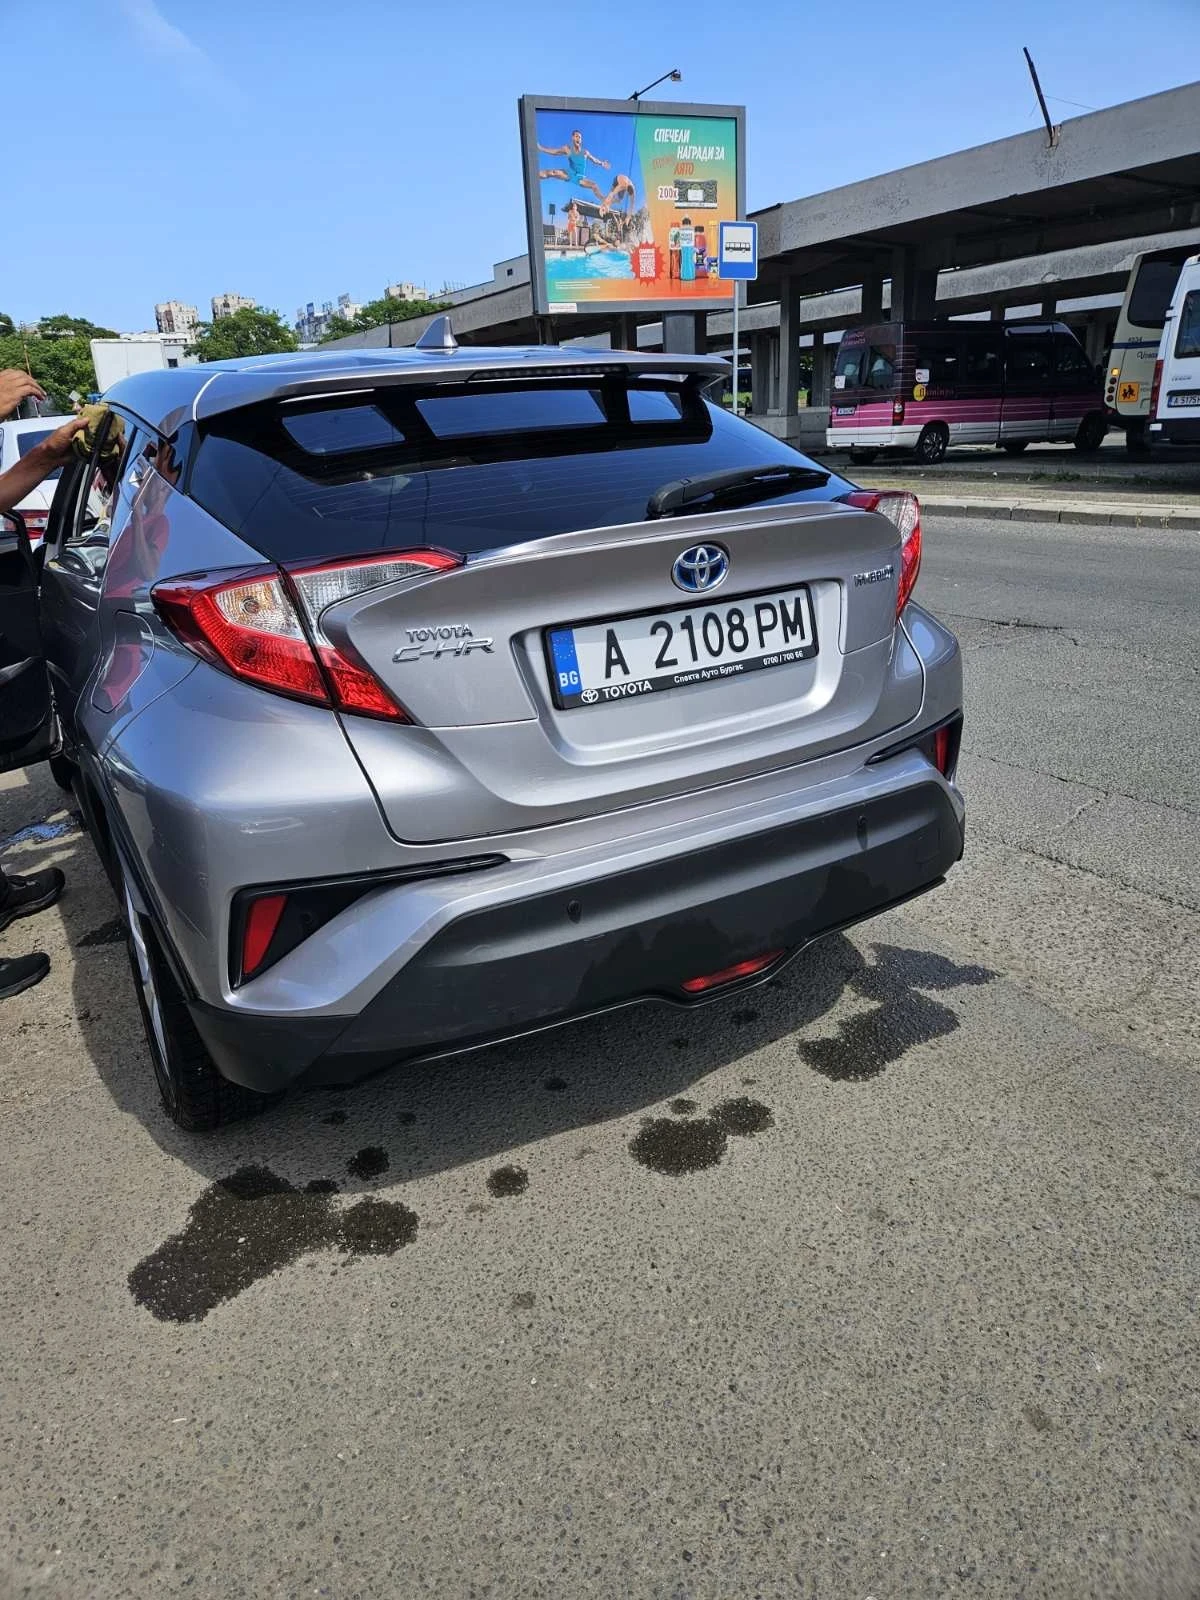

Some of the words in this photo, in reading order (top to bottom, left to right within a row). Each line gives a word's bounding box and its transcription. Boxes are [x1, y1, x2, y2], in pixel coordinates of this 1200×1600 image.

[654, 128, 690, 143] СПЕЧЕЛИ
[677, 145, 714, 161] НАГРАДИ
[714, 146, 725, 160] ЗА
[406, 624, 473, 642] TOYOTA
[605, 629, 631, 679] A
[650, 608, 749, 669] 2108
[754, 597, 806, 649] PM
[392, 637, 495, 663] C-HR
[559, 670, 579, 687] BG
[701, 669, 719, 679] Ауто
[719, 664, 744, 676] Бургас
[602, 680, 653, 699] TOYOTA
